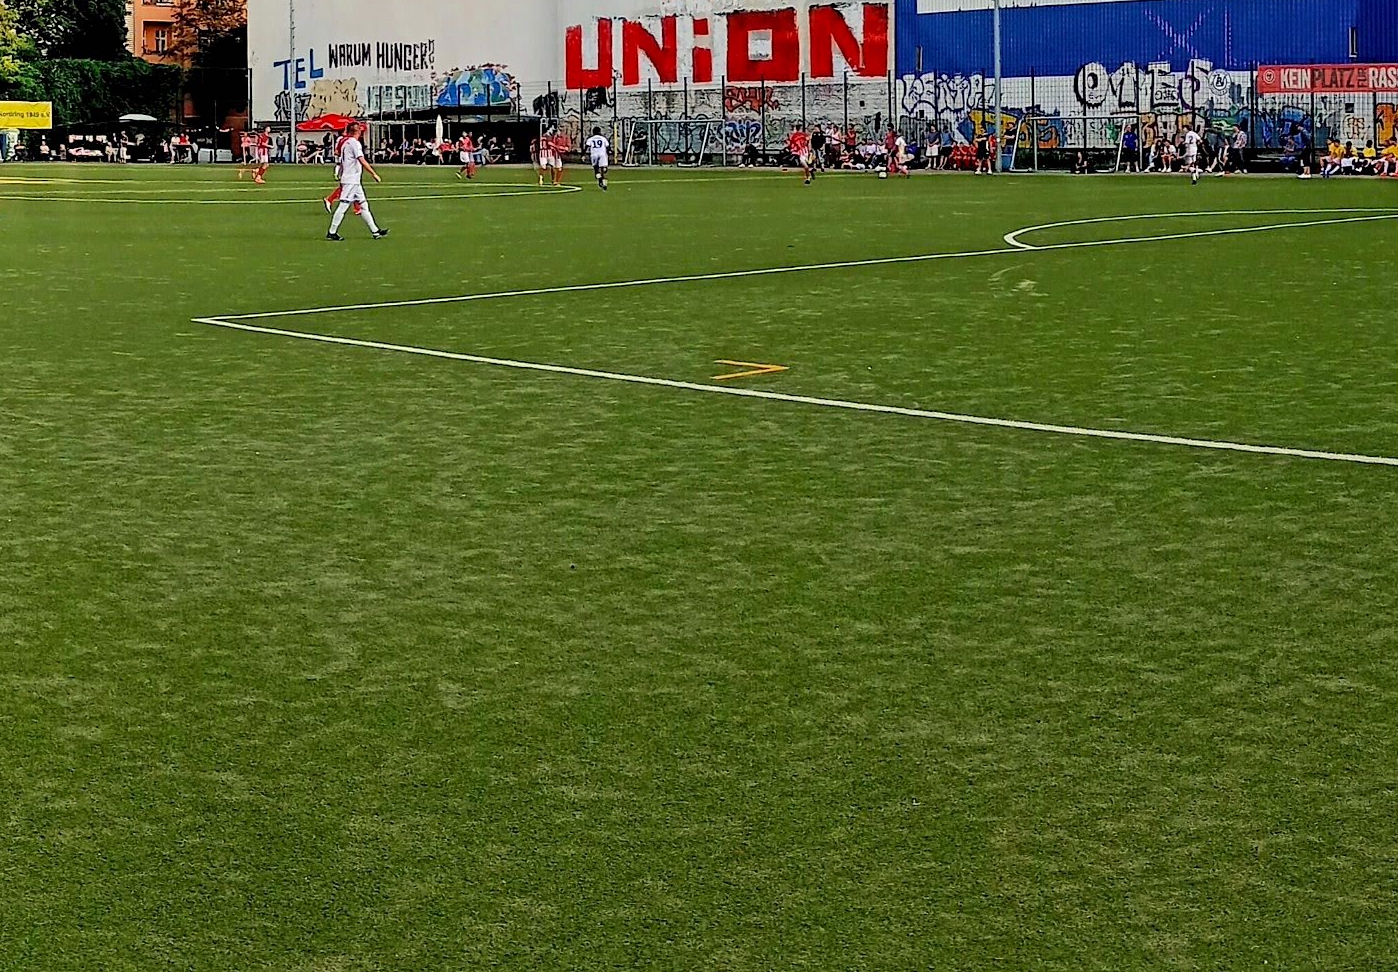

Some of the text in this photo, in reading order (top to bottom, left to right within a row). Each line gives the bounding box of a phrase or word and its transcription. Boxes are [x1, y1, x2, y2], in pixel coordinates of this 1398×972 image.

[328, 42, 372, 68] WARUM
[1281, 68, 1311, 89] KEIN
[1312, 67, 1355, 89] PLATZ
[592, 139, 603, 149] 19
